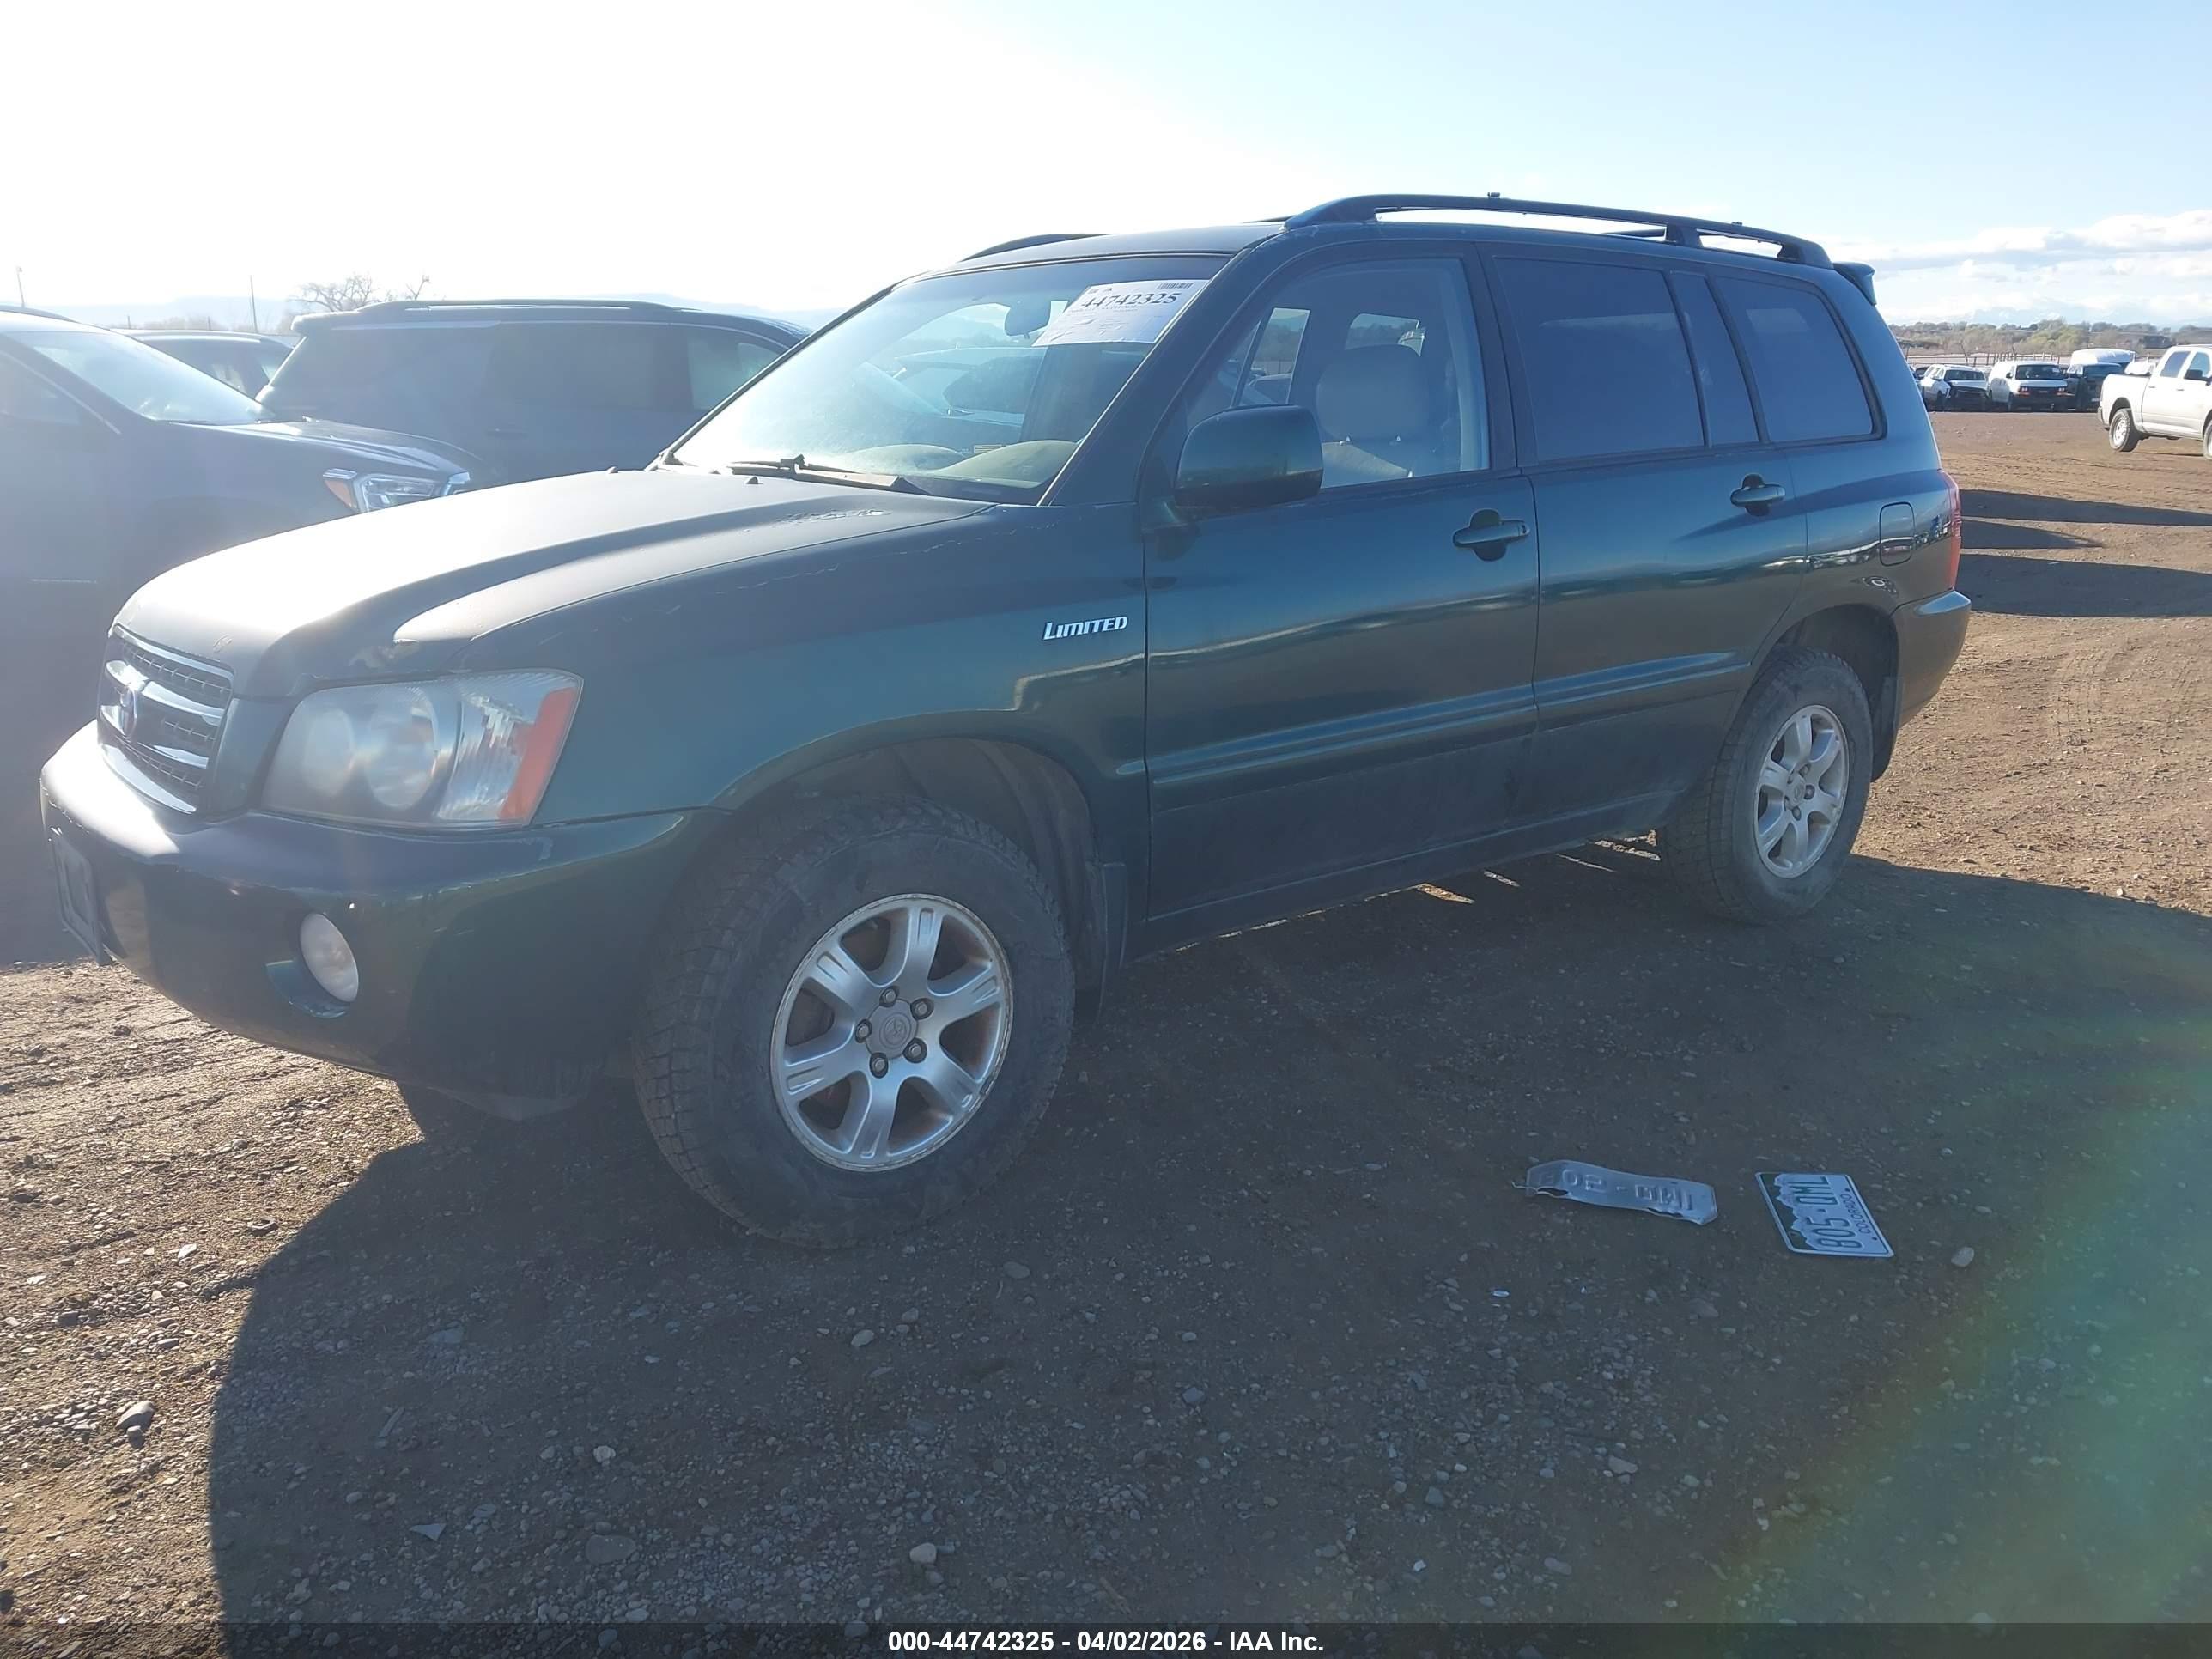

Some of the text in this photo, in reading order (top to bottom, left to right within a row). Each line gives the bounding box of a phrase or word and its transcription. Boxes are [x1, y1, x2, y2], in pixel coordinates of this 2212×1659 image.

[1081, 292, 1182, 308] 44742325
[1042, 616, 1128, 641] LIMITED
[1839, 1193, 1871, 1234] COLORADO
